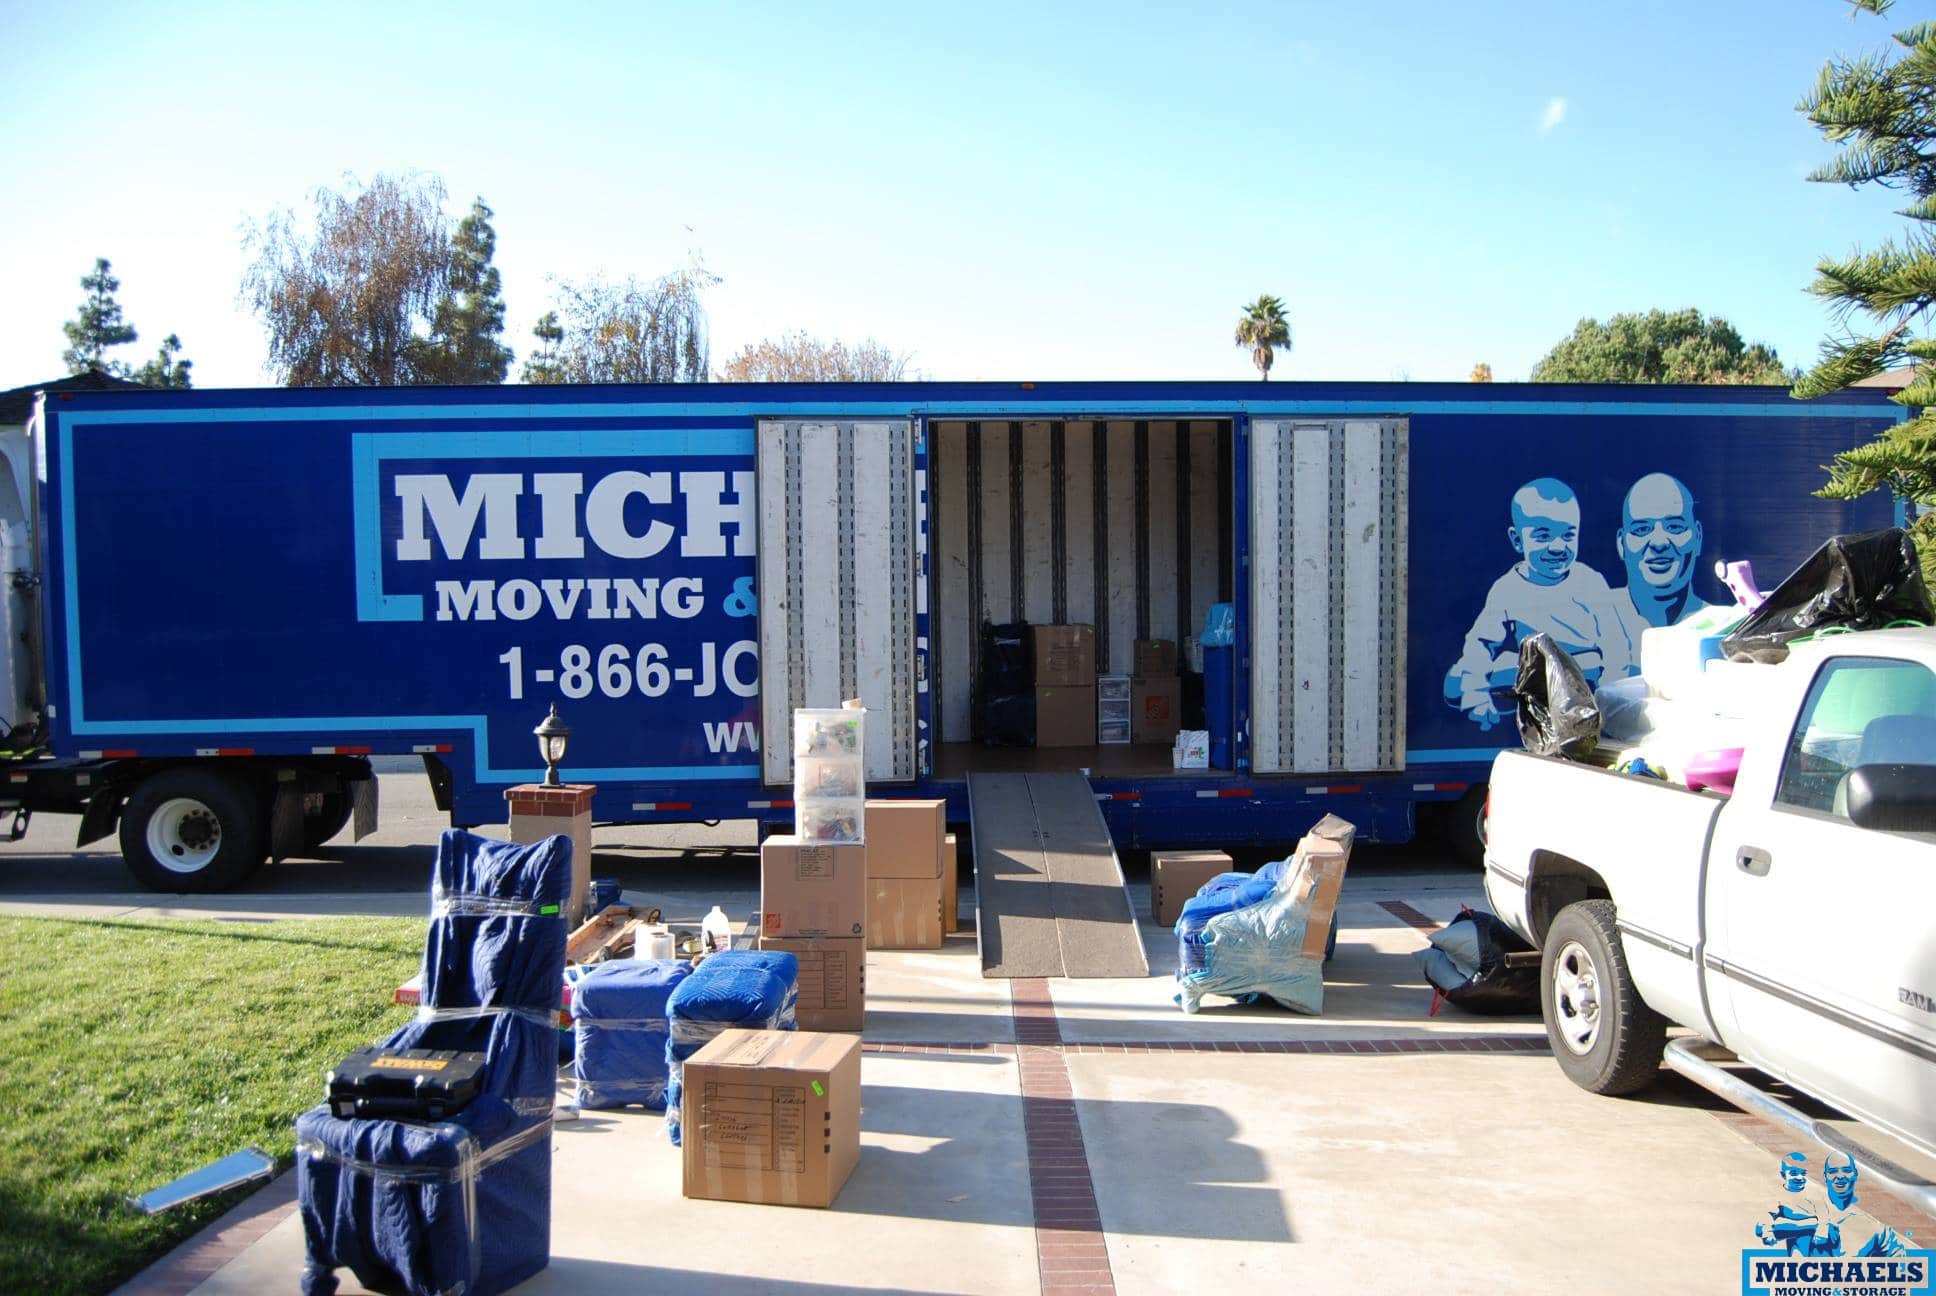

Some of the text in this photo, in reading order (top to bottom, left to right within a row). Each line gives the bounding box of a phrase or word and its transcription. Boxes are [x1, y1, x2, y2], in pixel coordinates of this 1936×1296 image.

[395, 470, 757, 561] MICH
[435, 577, 705, 622] MOVING
[1898, 986, 1932, 1013] RAM
